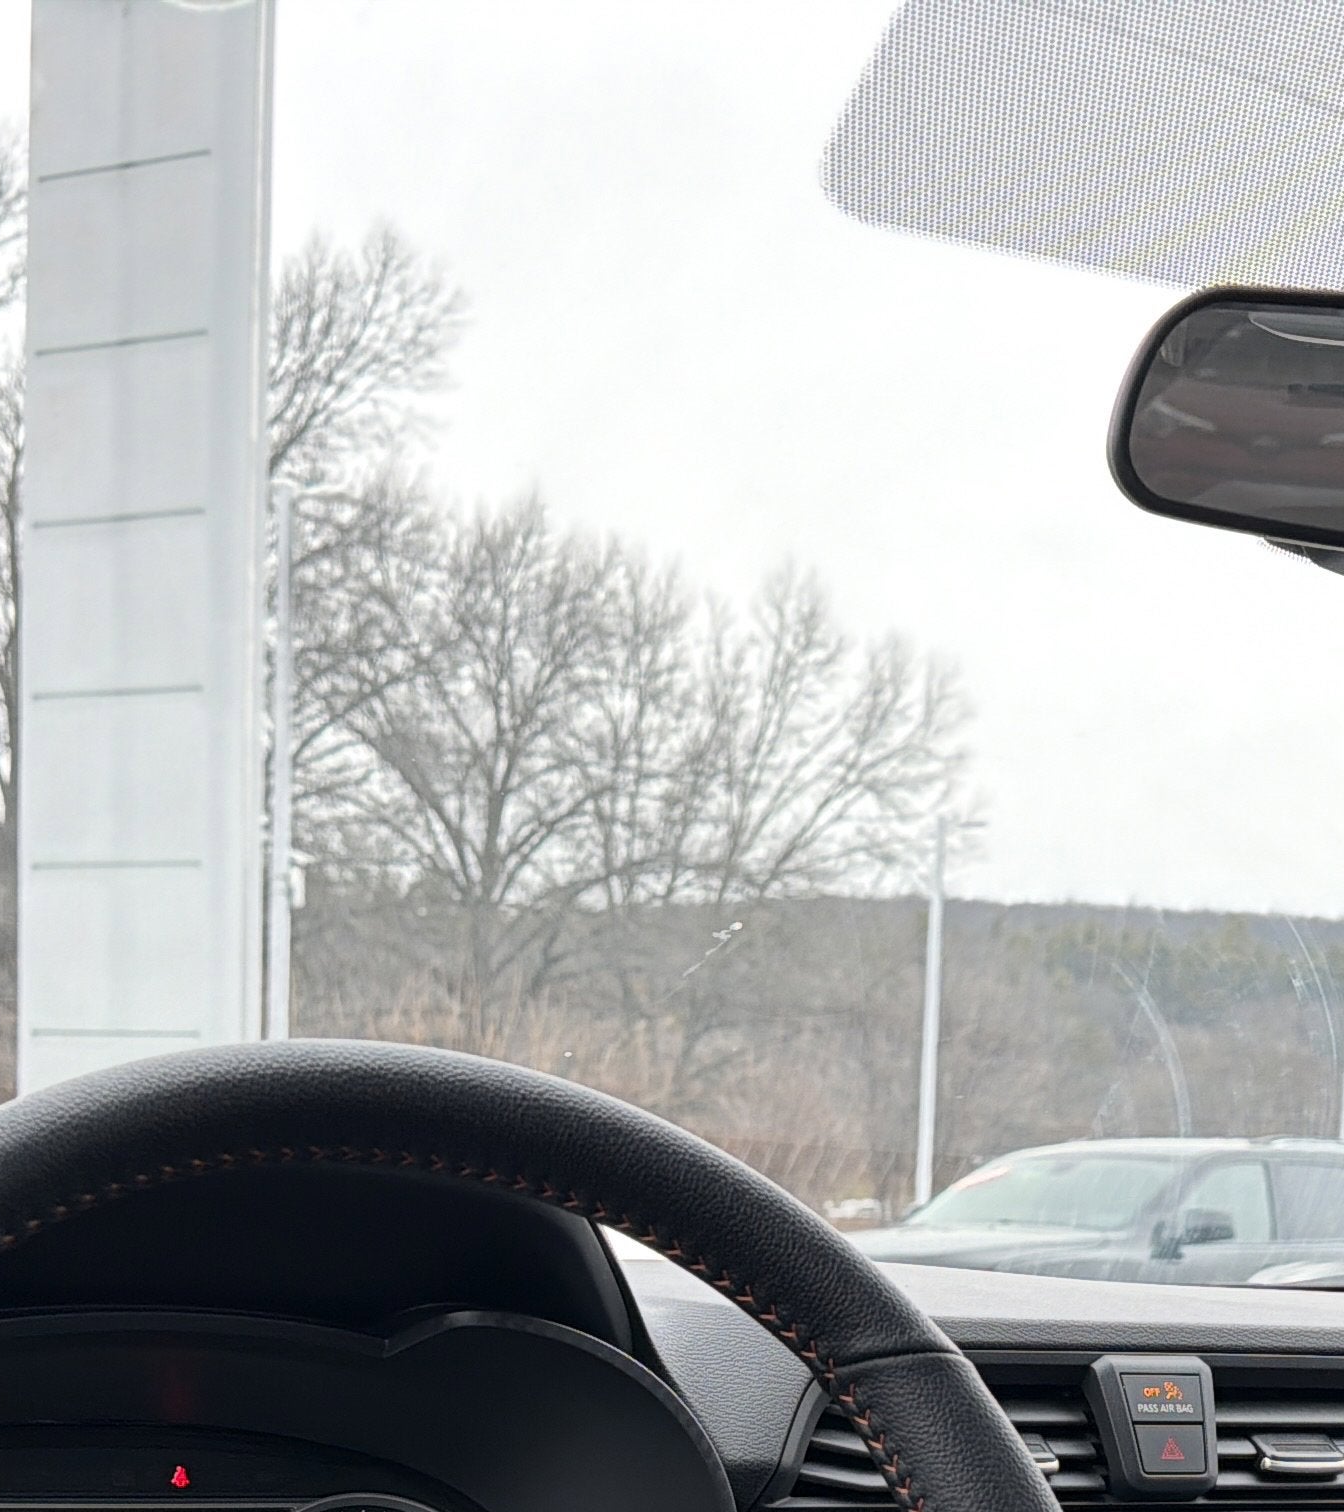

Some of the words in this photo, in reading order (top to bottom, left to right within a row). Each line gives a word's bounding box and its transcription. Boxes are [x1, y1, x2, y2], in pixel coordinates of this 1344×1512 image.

[1143, 1387, 1160, 1397] OFF
[1137, 1404, 1159, 1413] PASS
[1160, 1404, 1175, 1413] AIR
[1176, 1404, 1194, 1413] BAG
